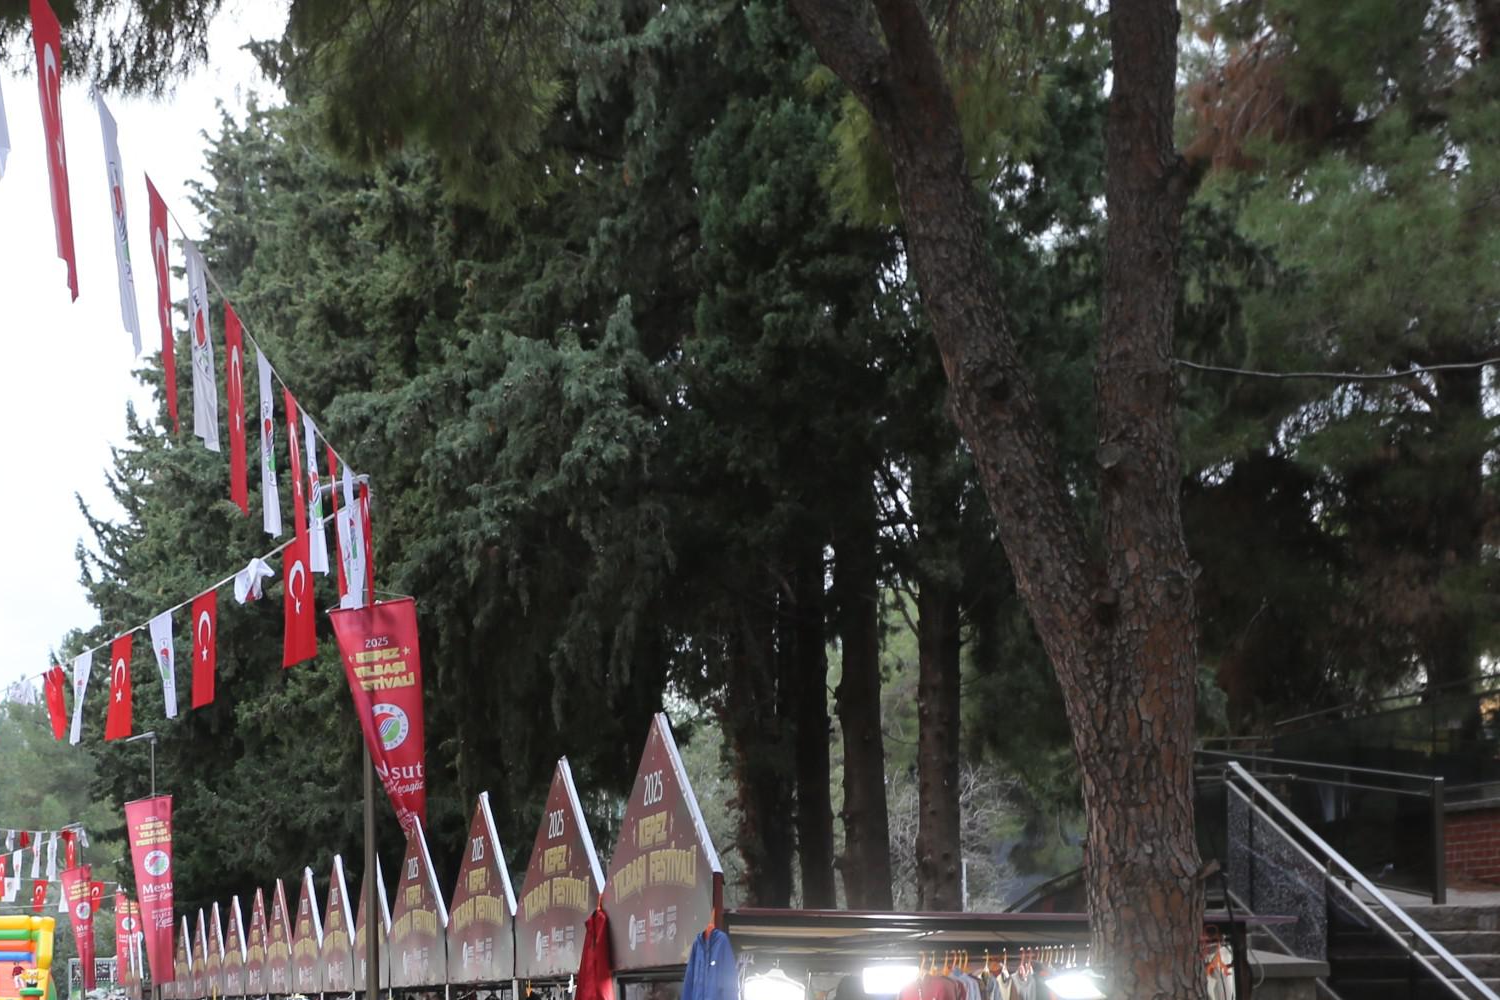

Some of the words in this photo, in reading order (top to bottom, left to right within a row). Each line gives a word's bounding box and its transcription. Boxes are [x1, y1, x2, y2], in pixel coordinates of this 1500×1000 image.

[365, 636, 389, 648] 2025
[643, 770, 663, 807] 2025
[548, 809, 564, 840] 2025
[142, 882, 173, 896] Mesu
